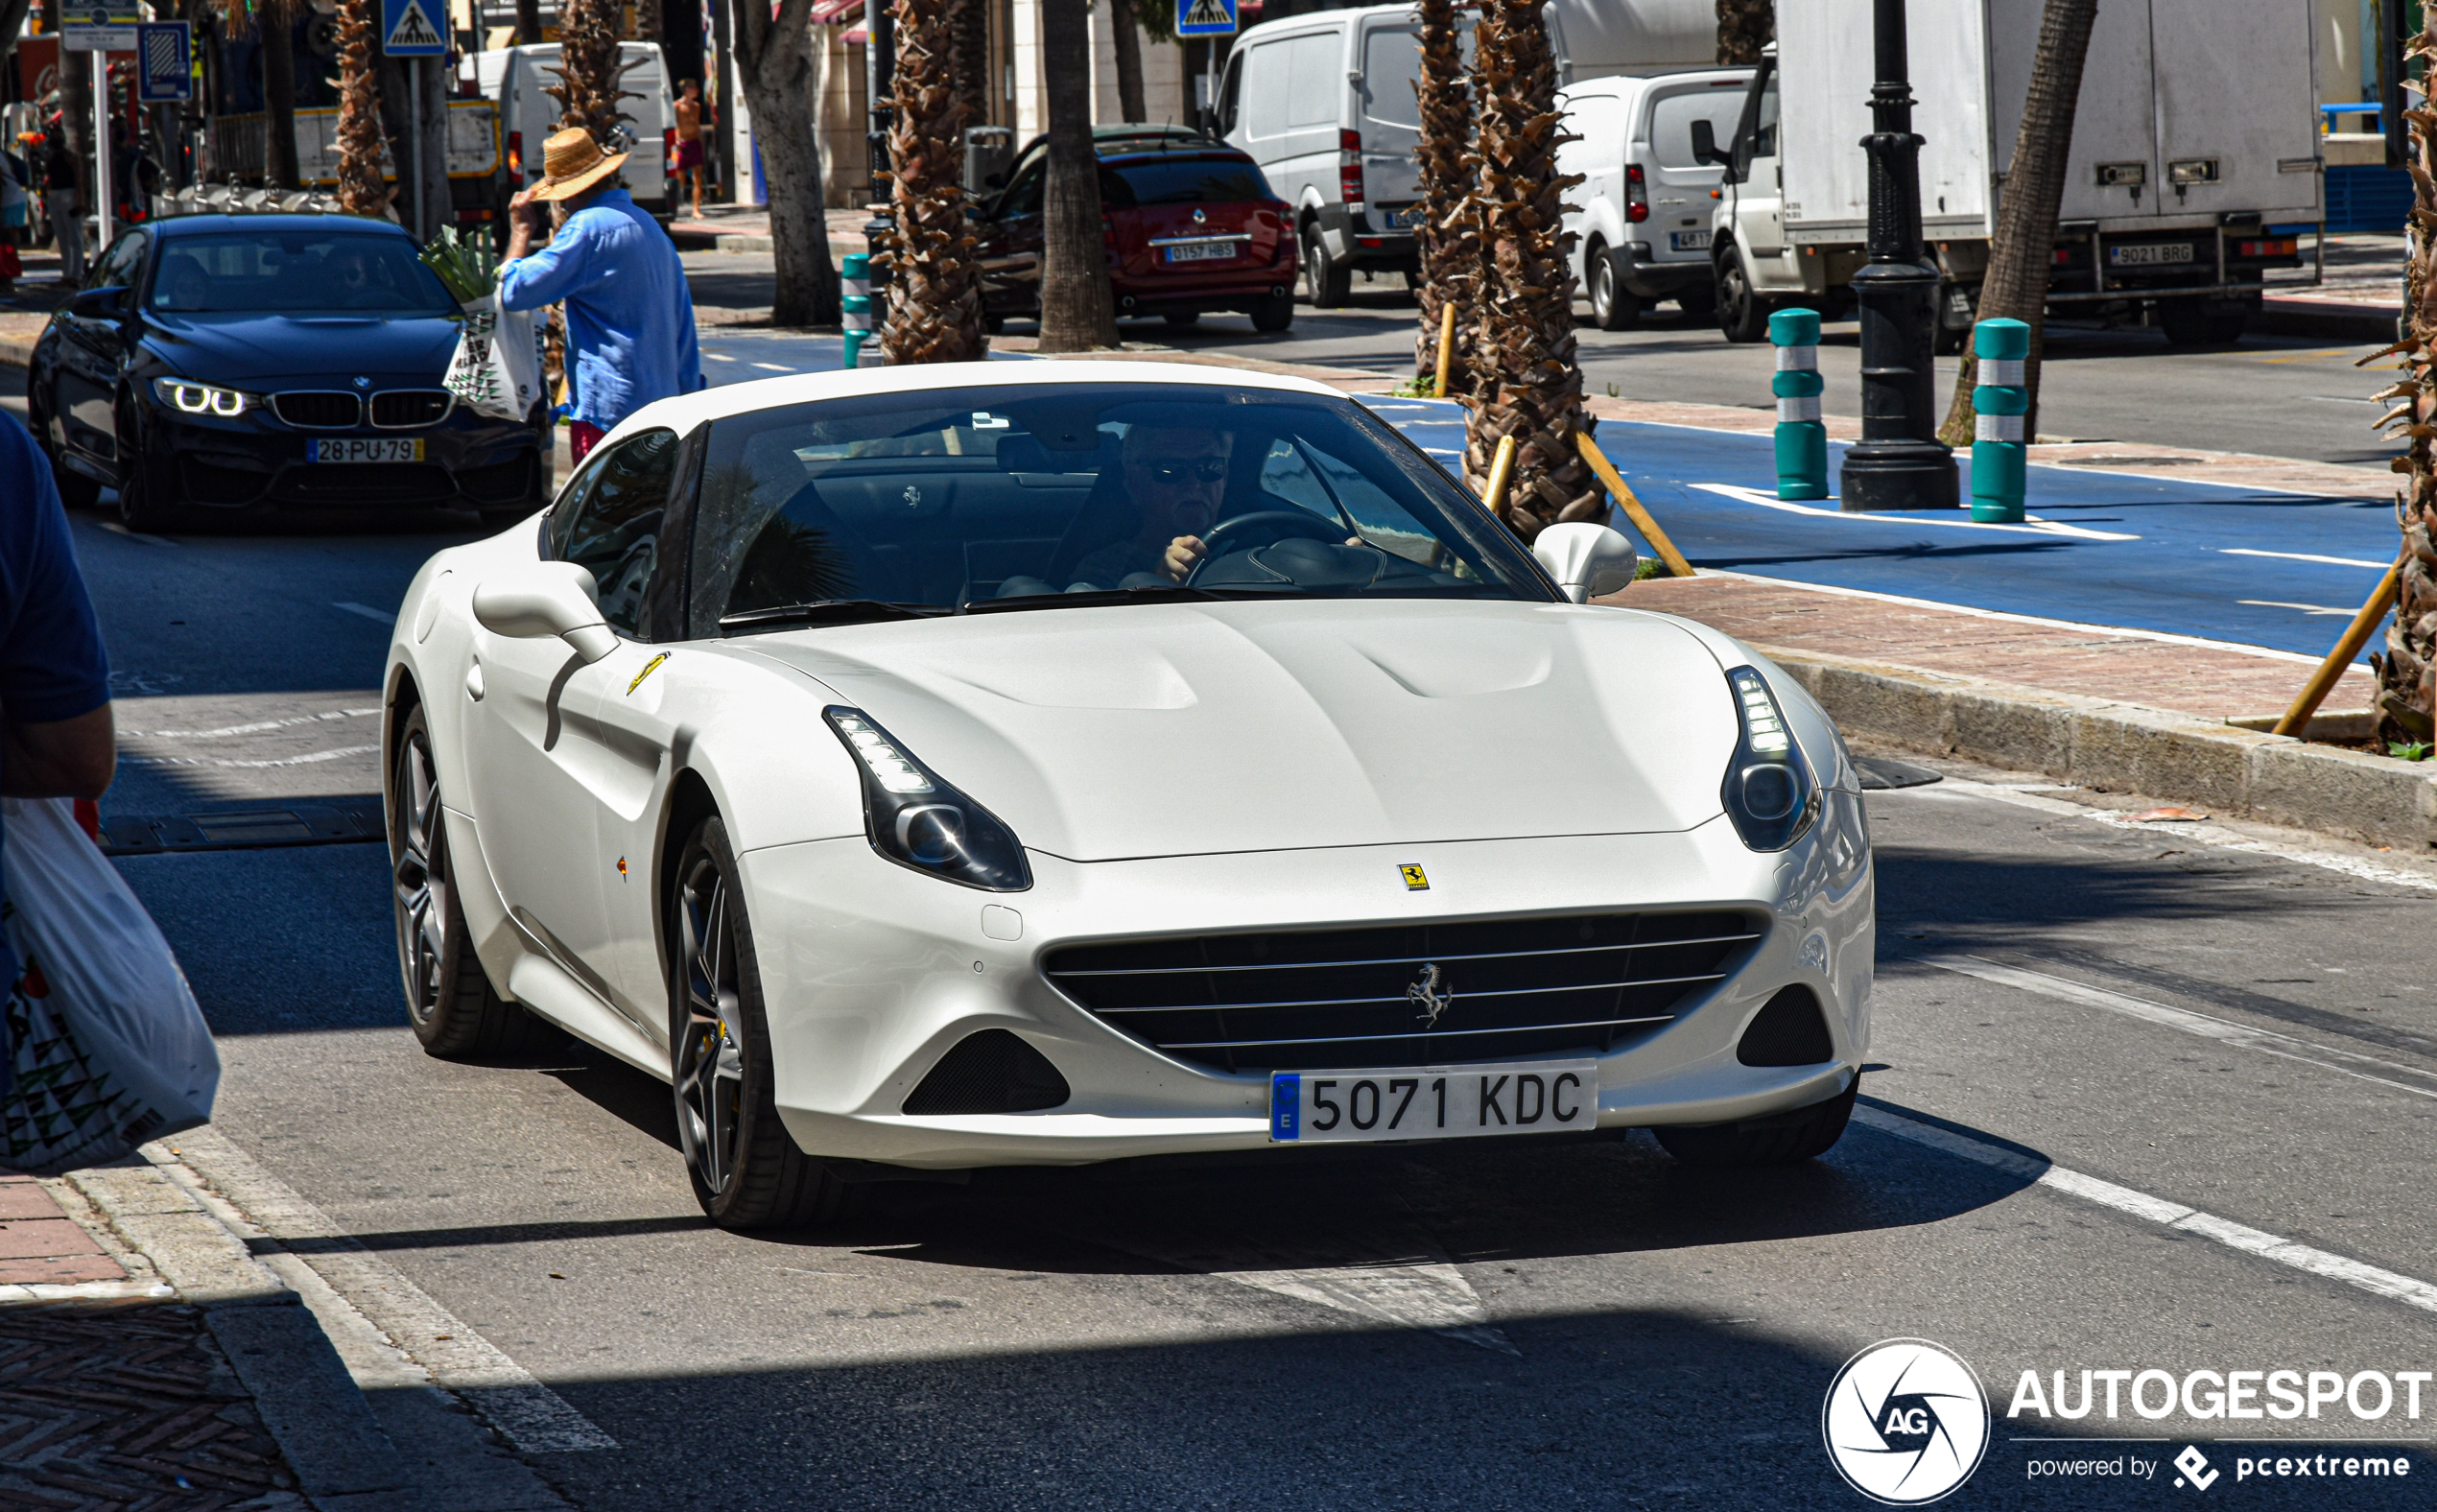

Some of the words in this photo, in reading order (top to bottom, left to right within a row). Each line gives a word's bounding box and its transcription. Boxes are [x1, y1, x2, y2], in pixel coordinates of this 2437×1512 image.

[1173, 246, 1205, 260] 0157
[1209, 243, 1233, 257] HBS
[2120, 248, 2157, 263] 9021
[2162, 246, 2189, 261] BRG
[1280, 1114, 1291, 1128] E
[1312, 1076, 1447, 1131] 5071
[1479, 1072, 1581, 1127] KDC
